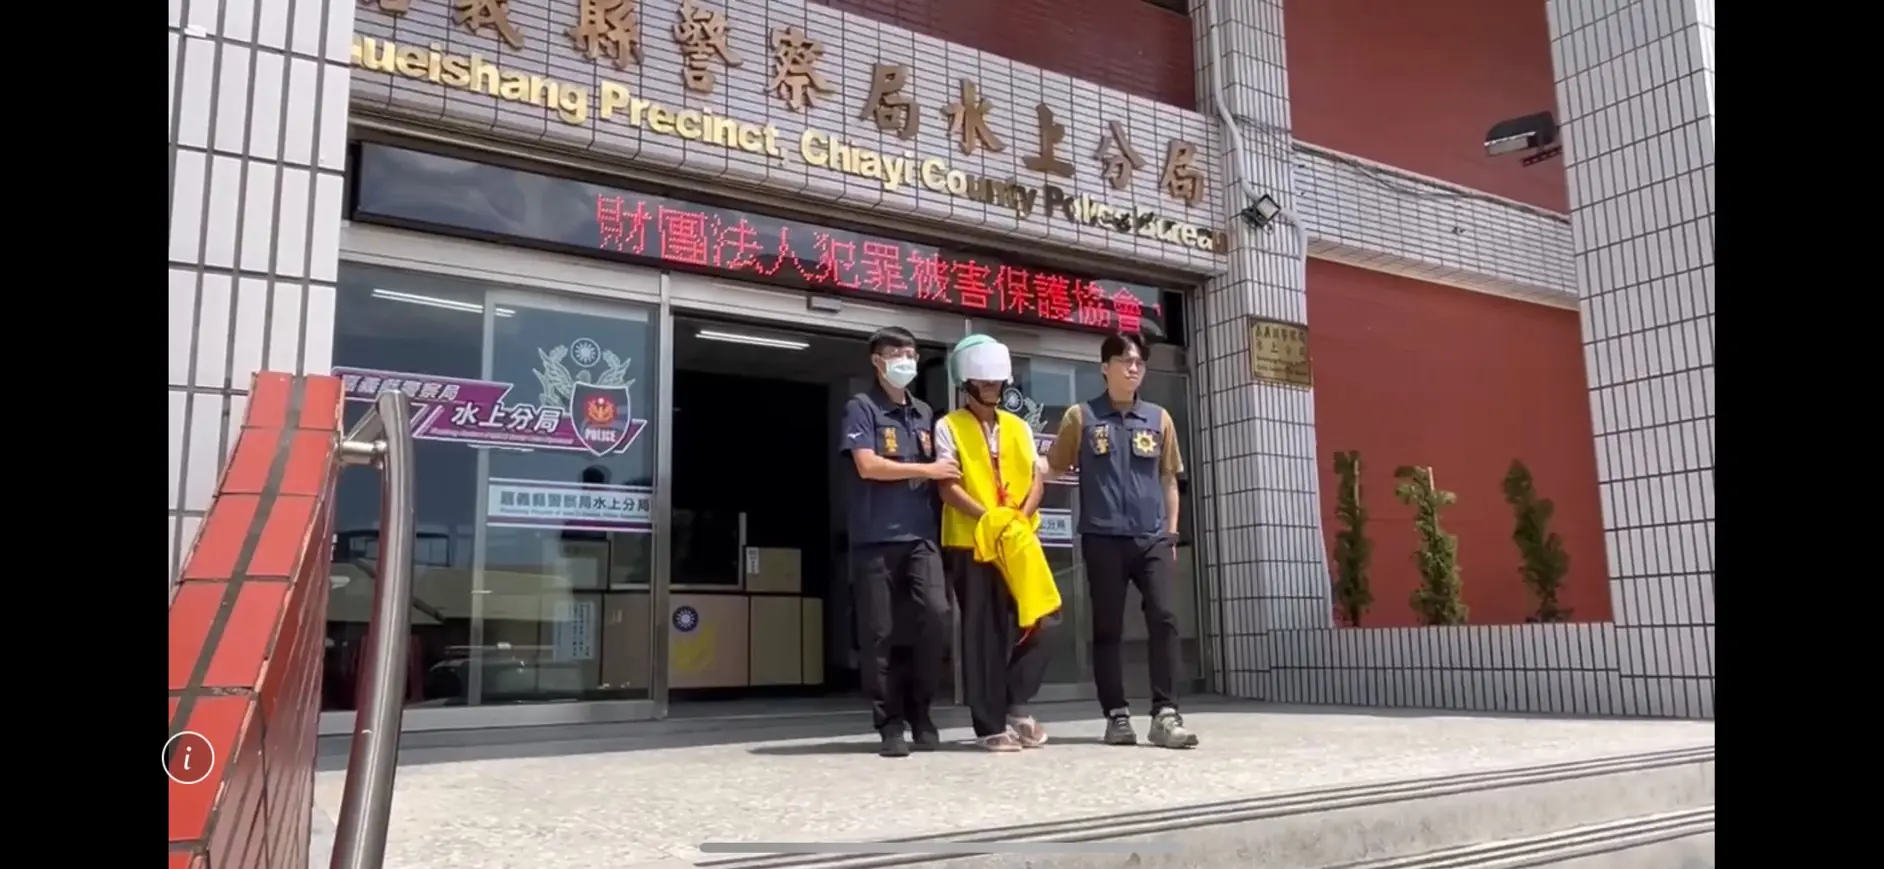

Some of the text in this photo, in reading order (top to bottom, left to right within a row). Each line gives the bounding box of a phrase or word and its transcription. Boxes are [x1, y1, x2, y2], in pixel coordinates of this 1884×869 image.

[353, 0, 1204, 207] 縣警察局水上分局
[600, 81, 789, 166] Precinct,
[800, 127, 914, 192] Chiayi
[922, 156, 1038, 219] County
[1044, 184, 1131, 232] Police
[597, 193, 1162, 332] 財團法人犯罪被害保護協會
[452, 402, 561, 433] 水上分局
[584, 428, 617, 442] POLICE
